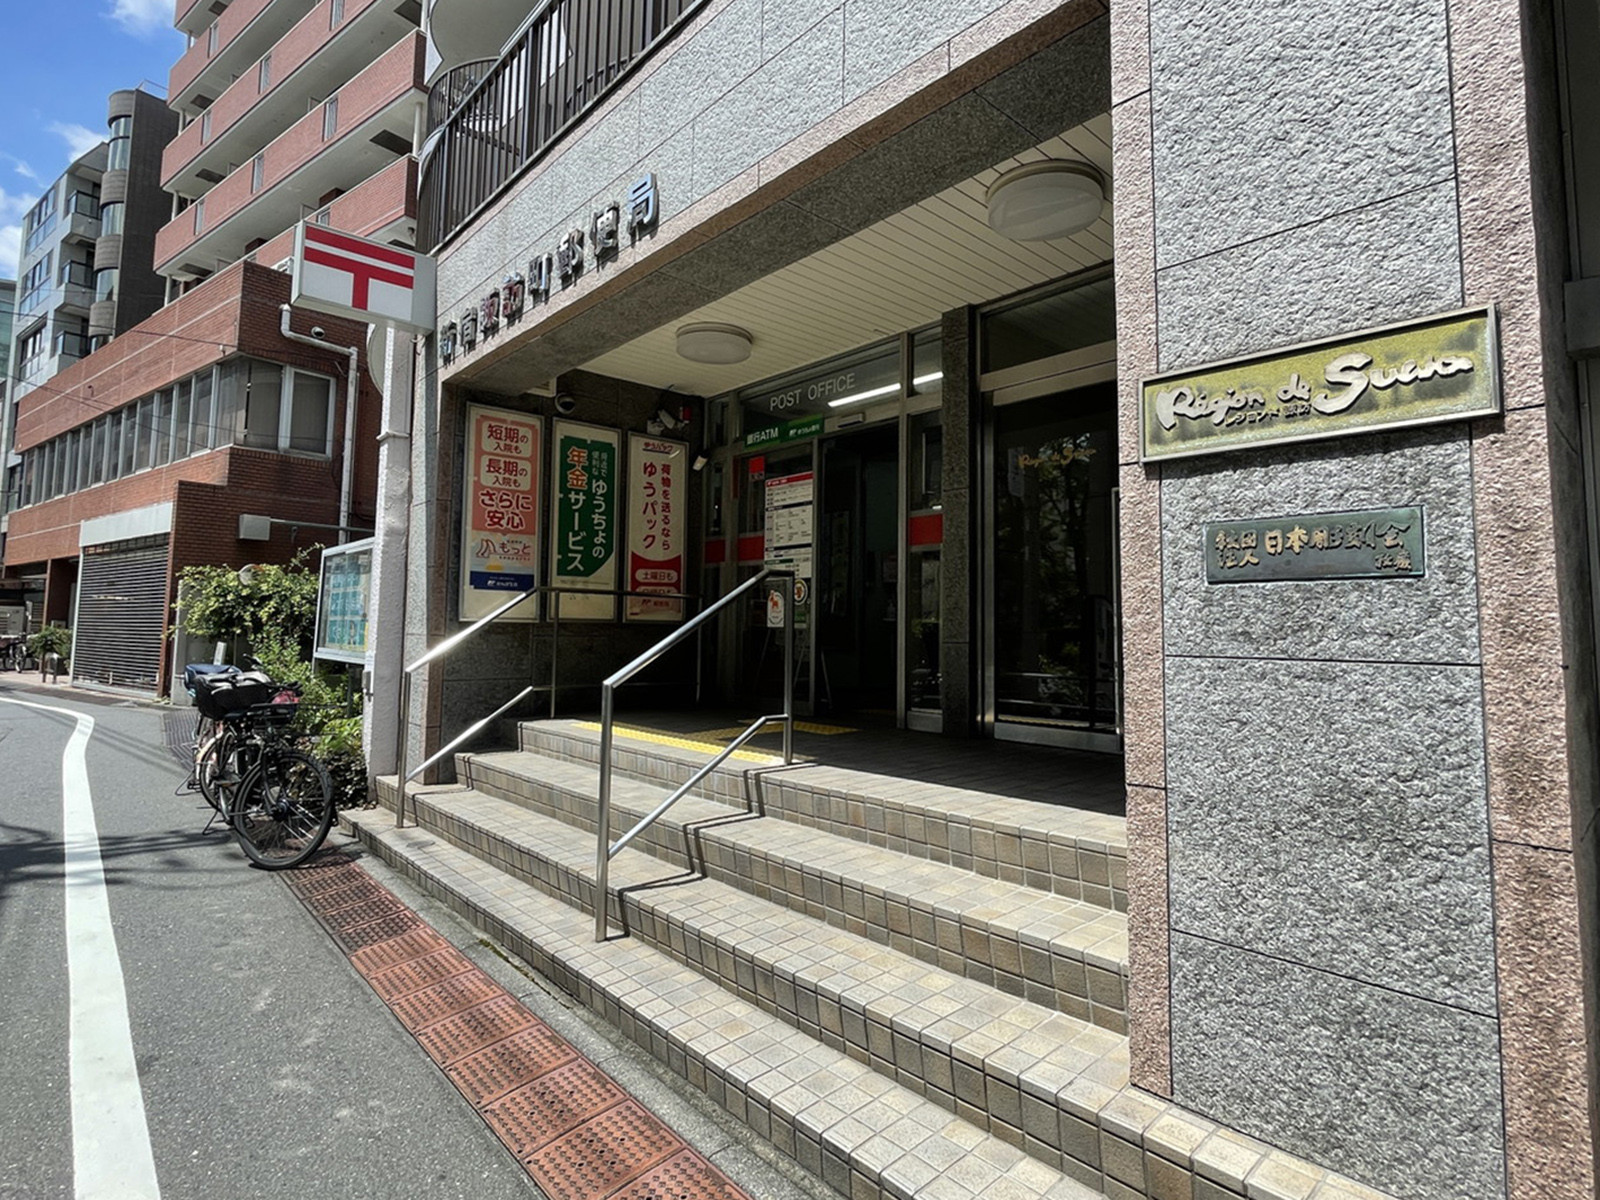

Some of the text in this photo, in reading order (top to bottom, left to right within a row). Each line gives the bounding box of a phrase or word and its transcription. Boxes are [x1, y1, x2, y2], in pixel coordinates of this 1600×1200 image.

[769, 374, 855, 411] POST OFFICE
[1276, 374, 1312, 401] de
[487, 423, 528, 444] 短期の
[493, 443, 523, 454] 入院も
[485, 457, 527, 477] 長期の
[492, 476, 521, 487] 入院も
[480, 490, 532, 511] さらに
[567, 447, 588, 571] 年金サービス
[642, 463, 657, 550] ゆうパック
[660, 463, 672, 551] 荷物を送るなら
[486, 511, 524, 529] 安心
[591, 479, 608, 559] ゆうちょの
[499, 542, 531, 554] もっと
[643, 571, 674, 580] 土曜日も
